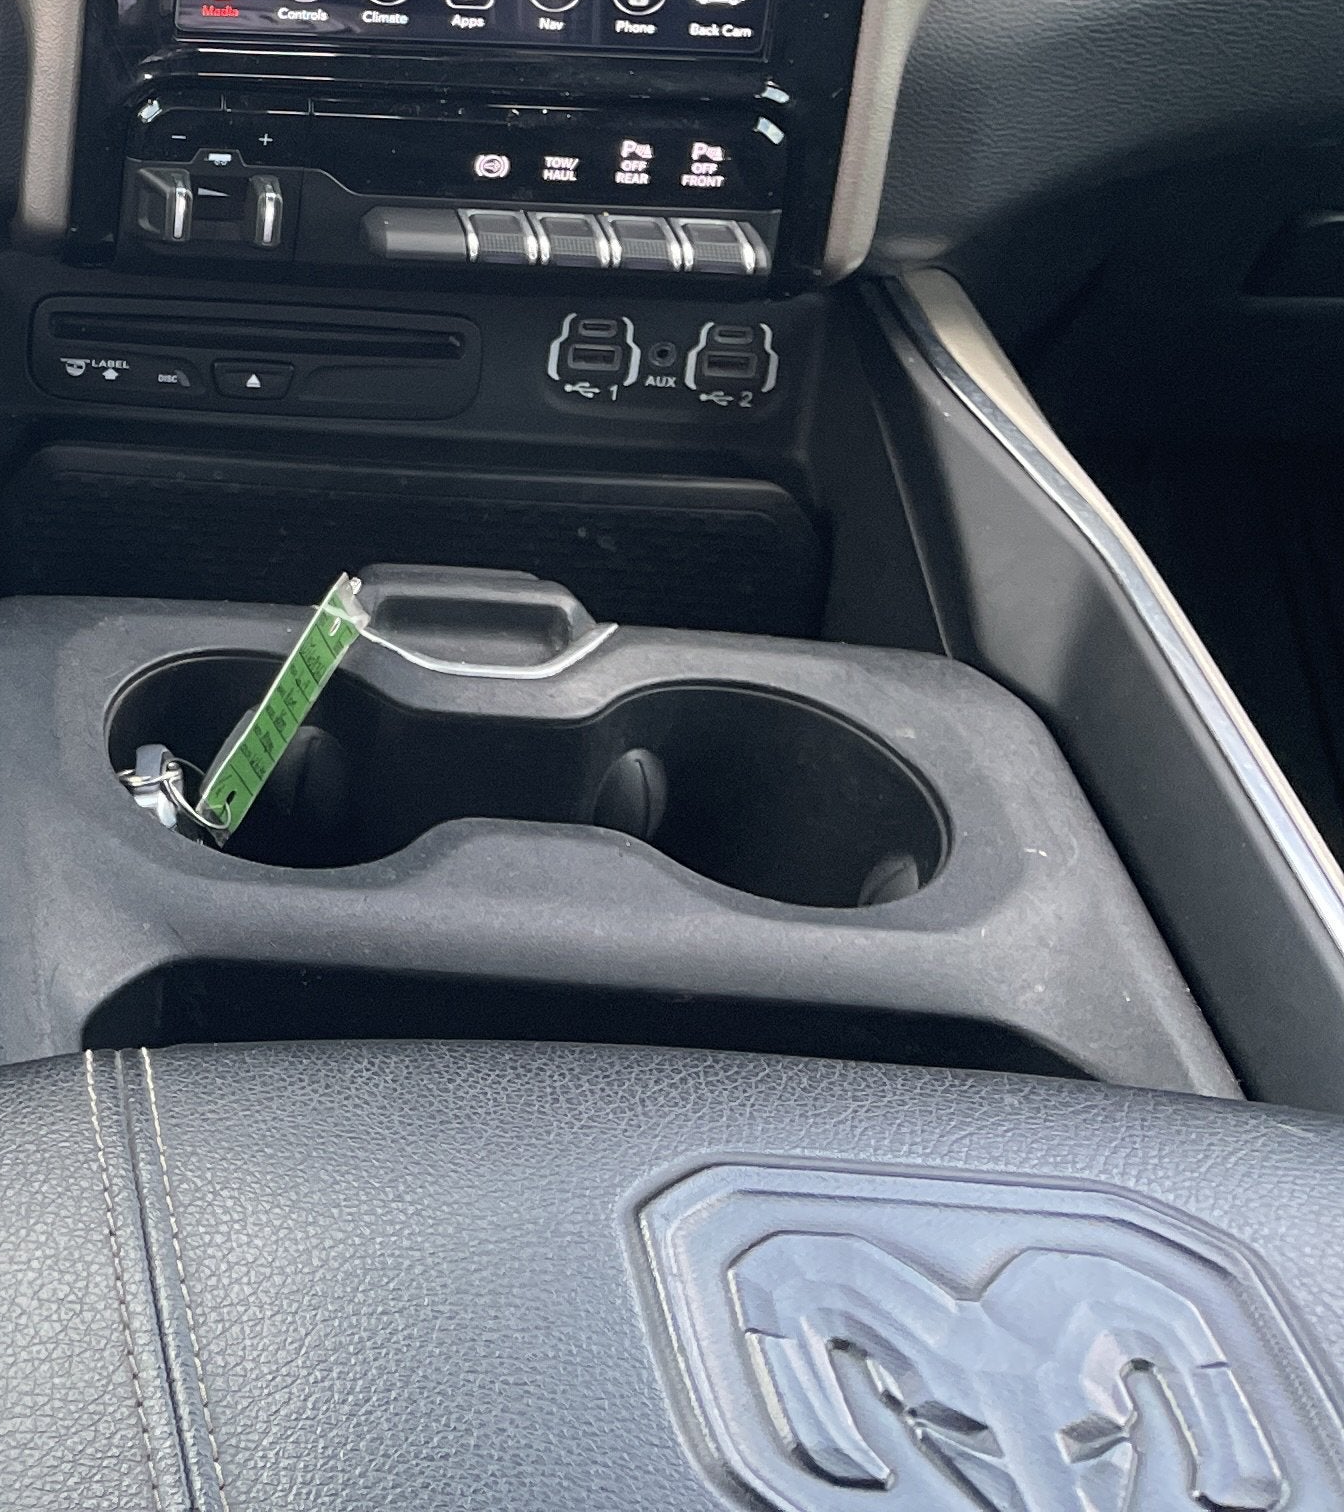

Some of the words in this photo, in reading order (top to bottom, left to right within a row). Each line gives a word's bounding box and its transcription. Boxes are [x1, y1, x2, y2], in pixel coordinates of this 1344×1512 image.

[202, 5, 239, 17] Media
[277, 7, 329, 22] Controls
[362, 10, 408, 24] Climate
[451, 14, 485, 29] Apps
[539, 17, 565, 30] Nav
[615, 20, 657, 35] Phone
[689, 22, 720, 37] Back
[723, 25, 753, 38] Cam
[544, 156, 579, 170] TOW/
[620, 160, 648, 172] OFF
[691, 162, 718, 174] OFF
[543, 169, 577, 181] HAUL
[615, 172, 650, 185] REAR
[681, 174, 725, 187] FRONT
[92, 359, 130, 369] LABEL
[158, 374, 178, 383] DISC
[645, 375, 676, 388] AUX
[610, 384, 618, 401] 1
[738, 391, 753, 407] 2
